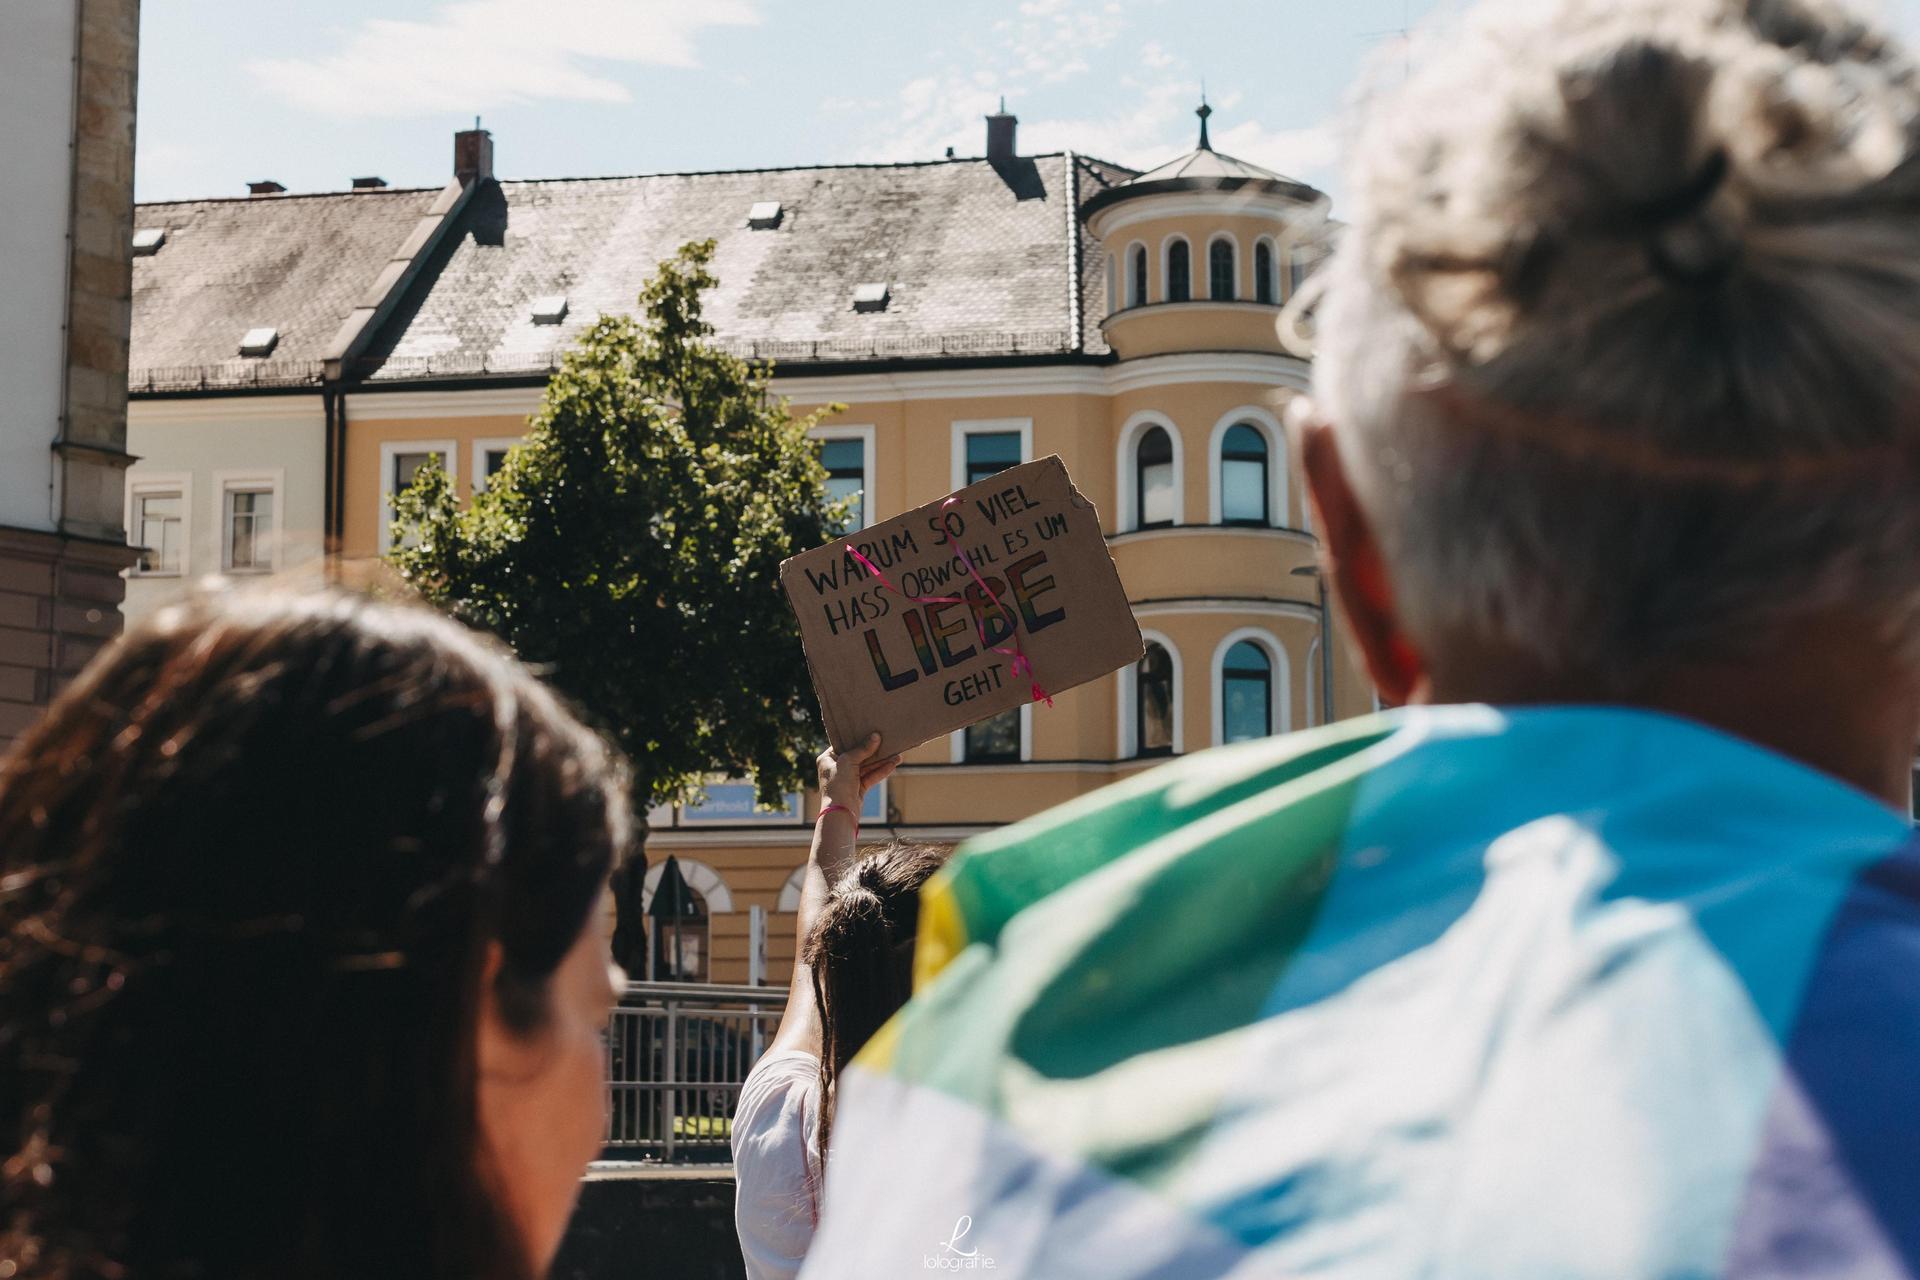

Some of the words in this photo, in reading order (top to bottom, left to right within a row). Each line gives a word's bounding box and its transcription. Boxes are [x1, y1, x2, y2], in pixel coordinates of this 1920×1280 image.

[804, 530, 919, 596] WARUM
[928, 511, 965, 546] SO
[976, 485, 1040, 526] VIEL
[823, 586, 890, 635] HASS
[901, 544, 999, 600] OBWOHL
[1002, 529, 1029, 555] ES
[1035, 512, 1069, 541] UM
[863, 550, 1066, 692] LIEBE
[943, 663, 1002, 706] GEHT
